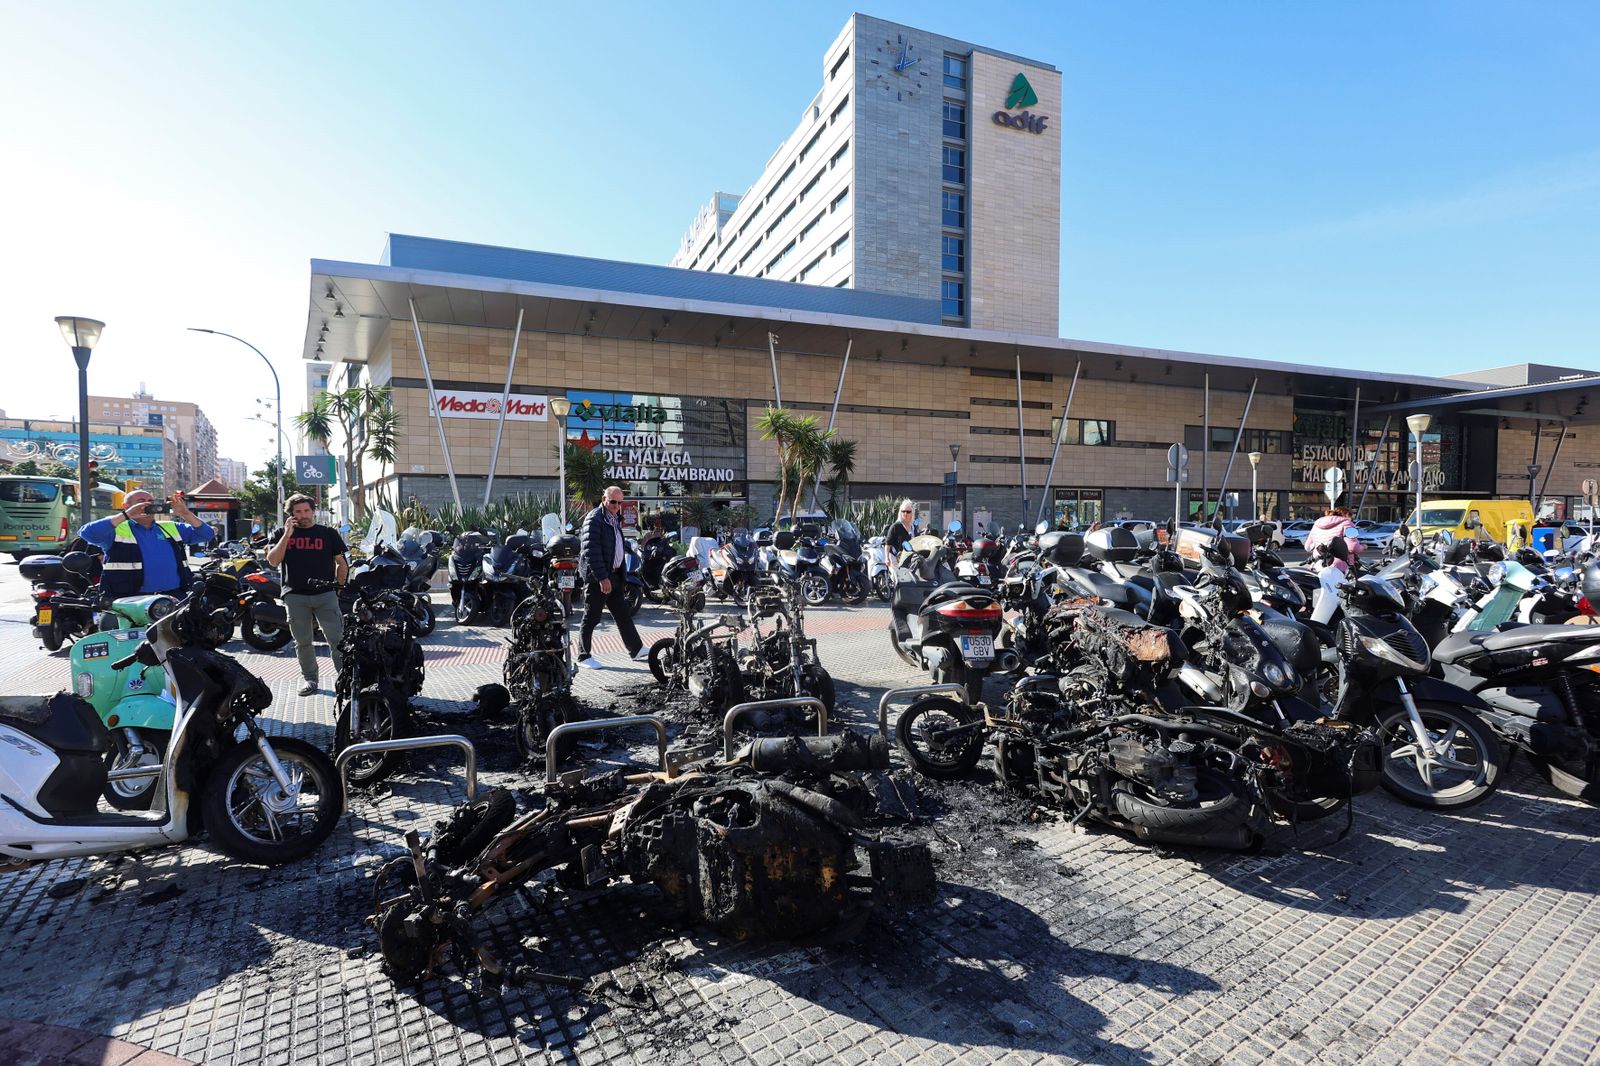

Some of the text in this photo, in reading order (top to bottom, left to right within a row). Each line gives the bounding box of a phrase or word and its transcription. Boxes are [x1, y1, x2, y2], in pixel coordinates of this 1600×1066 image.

[992, 111, 1048, 134] adif
[600, 403, 667, 424] vialia
[602, 431, 667, 447] ESTACIÓN
[603, 447, 692, 465] DE MÁLAGA
[1303, 443, 1351, 461] ESTACIÓN
[603, 464, 734, 482] MARÍA ZAMBRANO
[1303, 466, 1347, 483] MÁLA
[287, 537, 324, 550] POLO
[969, 636, 992, 646] 0530
[973, 646, 990, 656] GBV
